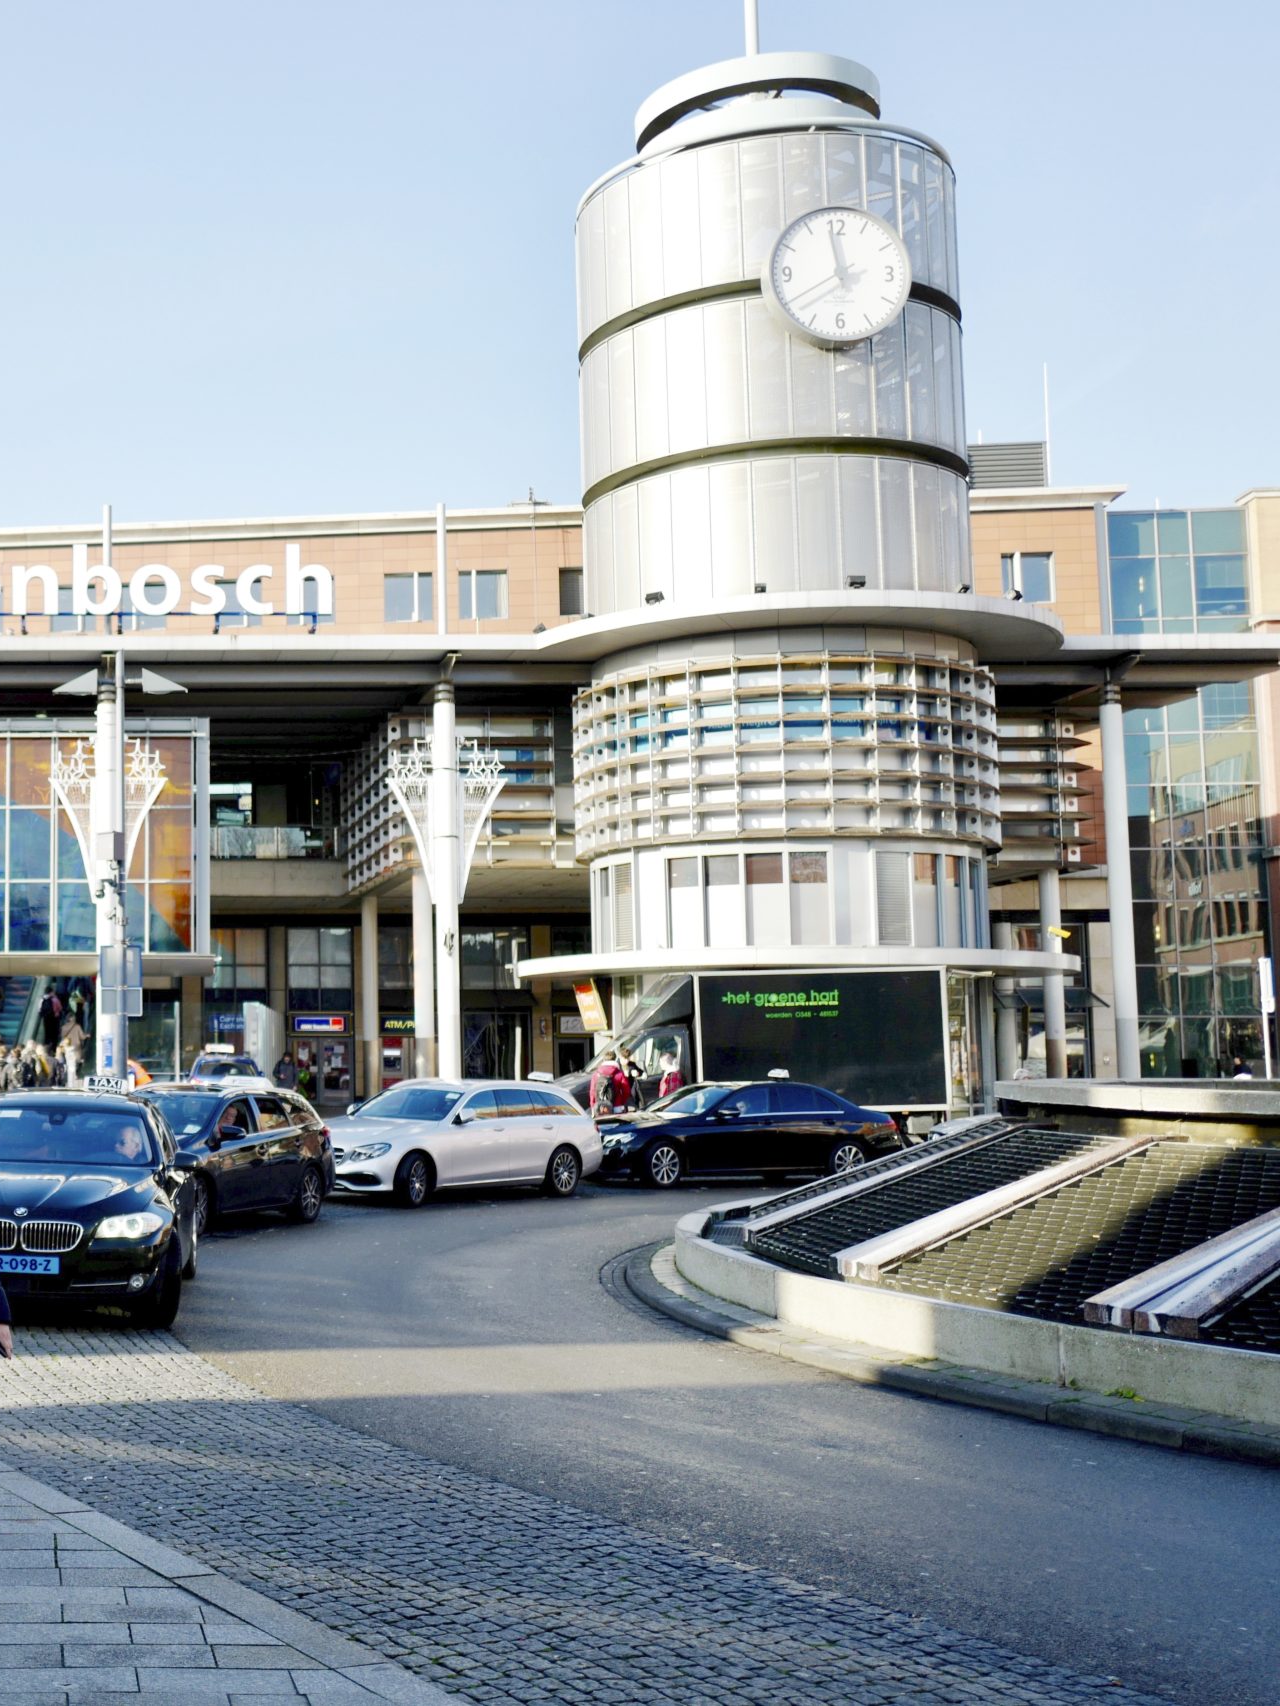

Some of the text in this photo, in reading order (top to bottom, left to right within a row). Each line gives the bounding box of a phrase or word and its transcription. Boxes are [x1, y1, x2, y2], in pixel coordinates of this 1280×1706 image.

[827, 219, 846, 236] 12
[782, 266, 894, 283] 9 3
[835, 312, 845, 329] 6
[810, 989, 839, 1002] hart
[94, 1077, 123, 1090] TAXI
